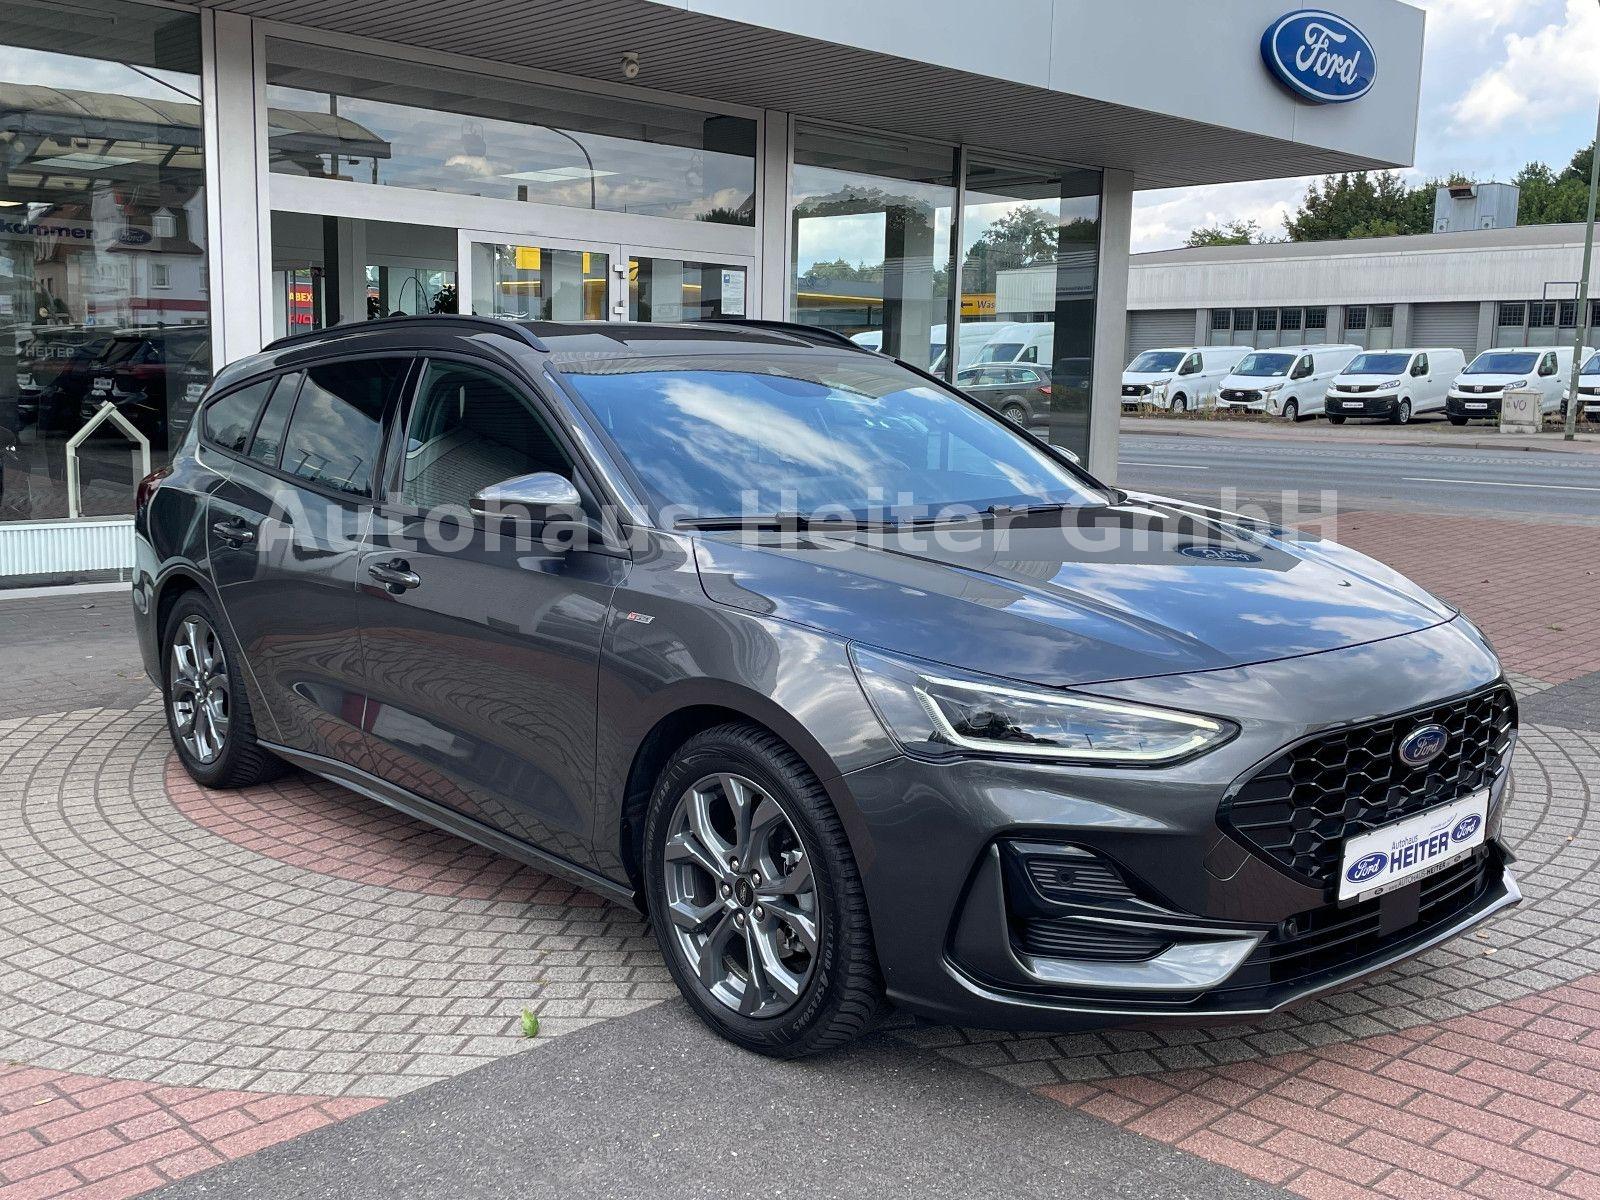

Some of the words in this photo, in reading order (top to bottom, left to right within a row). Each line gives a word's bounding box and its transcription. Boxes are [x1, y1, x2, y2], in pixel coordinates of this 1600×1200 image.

[1295, 22, 1361, 85] Ford
[1413, 735, 1440, 757] Ford
[1456, 817, 1478, 839] Ford
[1389, 830, 1450, 874] HEITER
[1391, 834, 1419, 851] Autohaus
[1354, 857, 1382, 879] Ford
